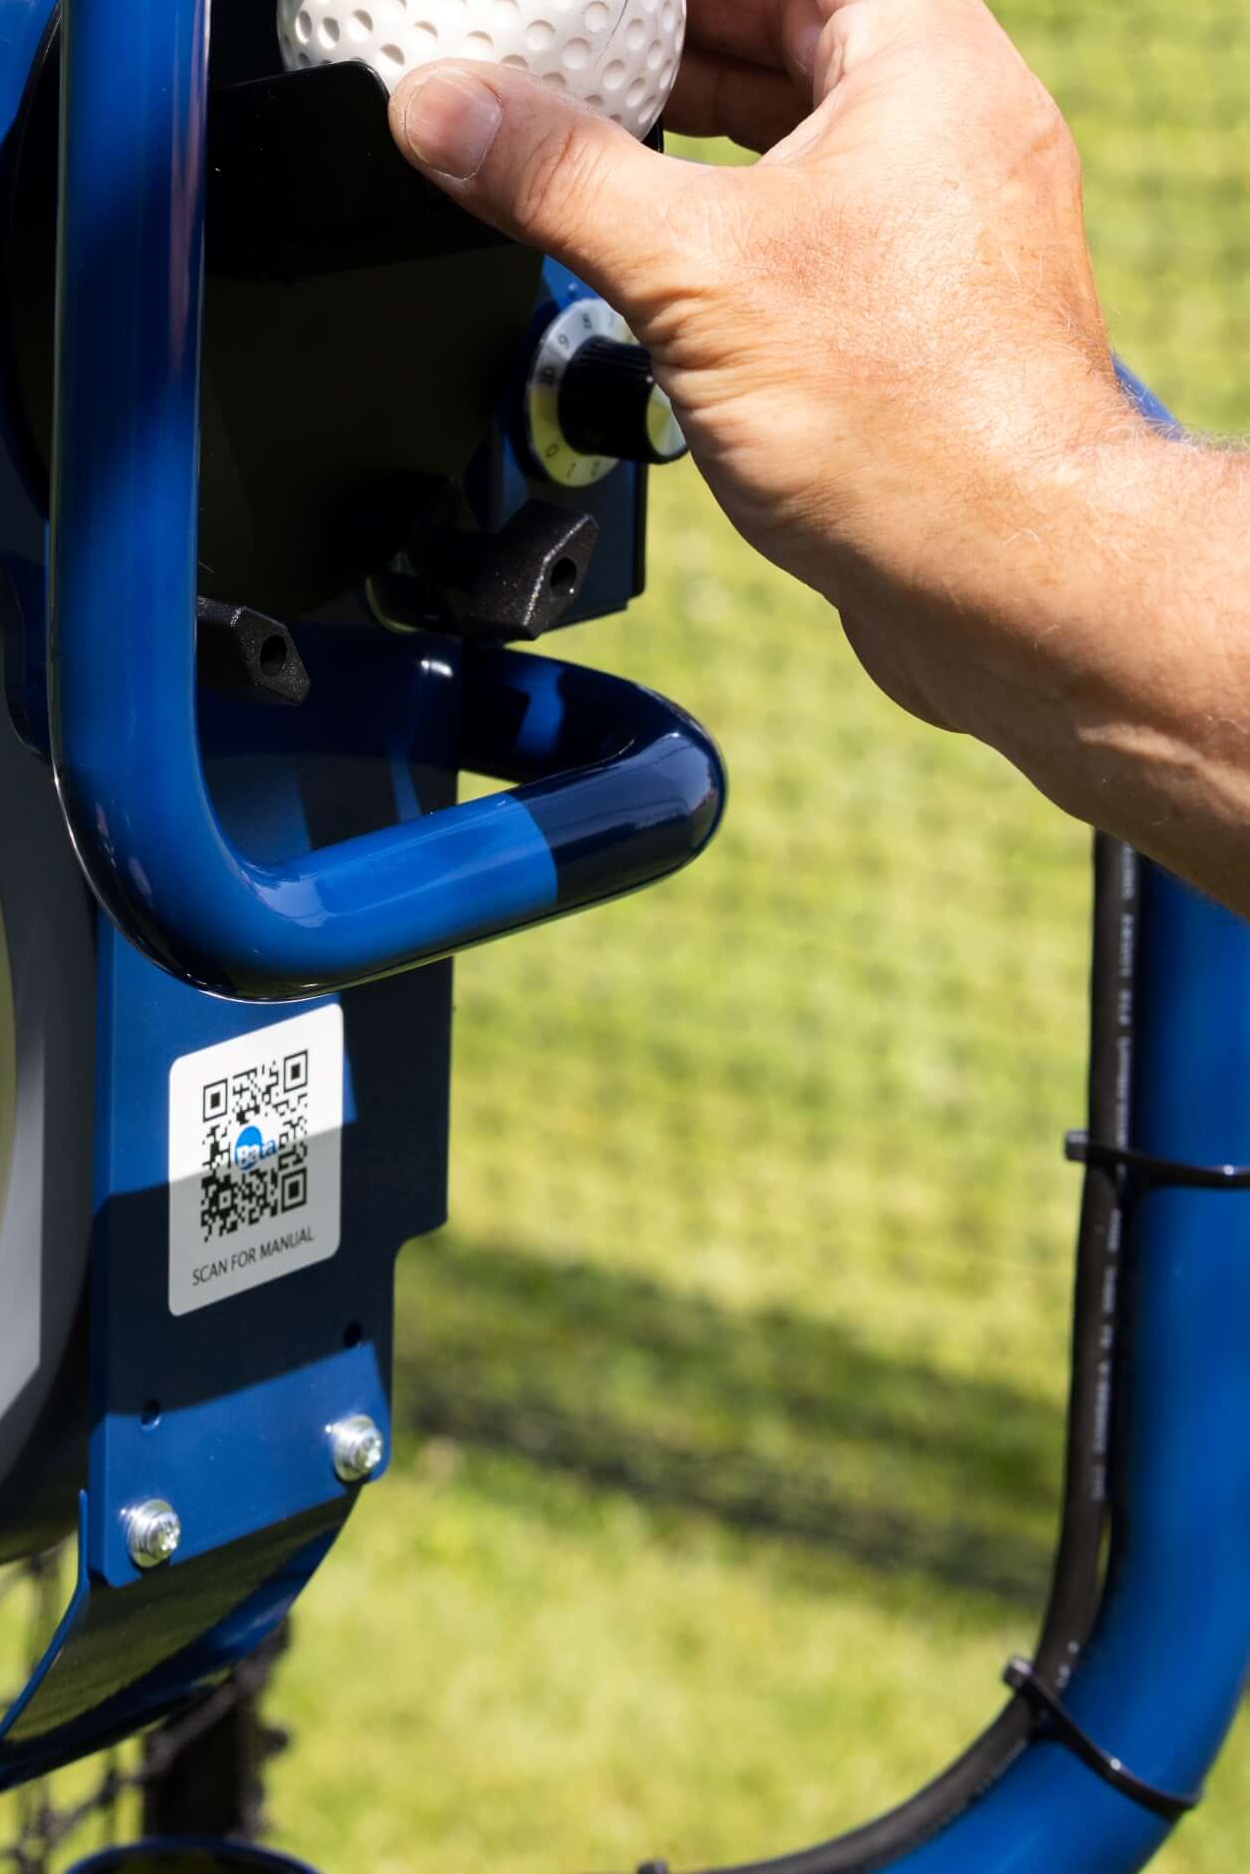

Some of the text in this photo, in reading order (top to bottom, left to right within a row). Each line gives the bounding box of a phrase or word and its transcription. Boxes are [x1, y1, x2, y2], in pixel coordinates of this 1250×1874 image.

[236, 1139, 277, 1164] Bata
[192, 1225, 315, 1286] SCAN FOR MANUAL
